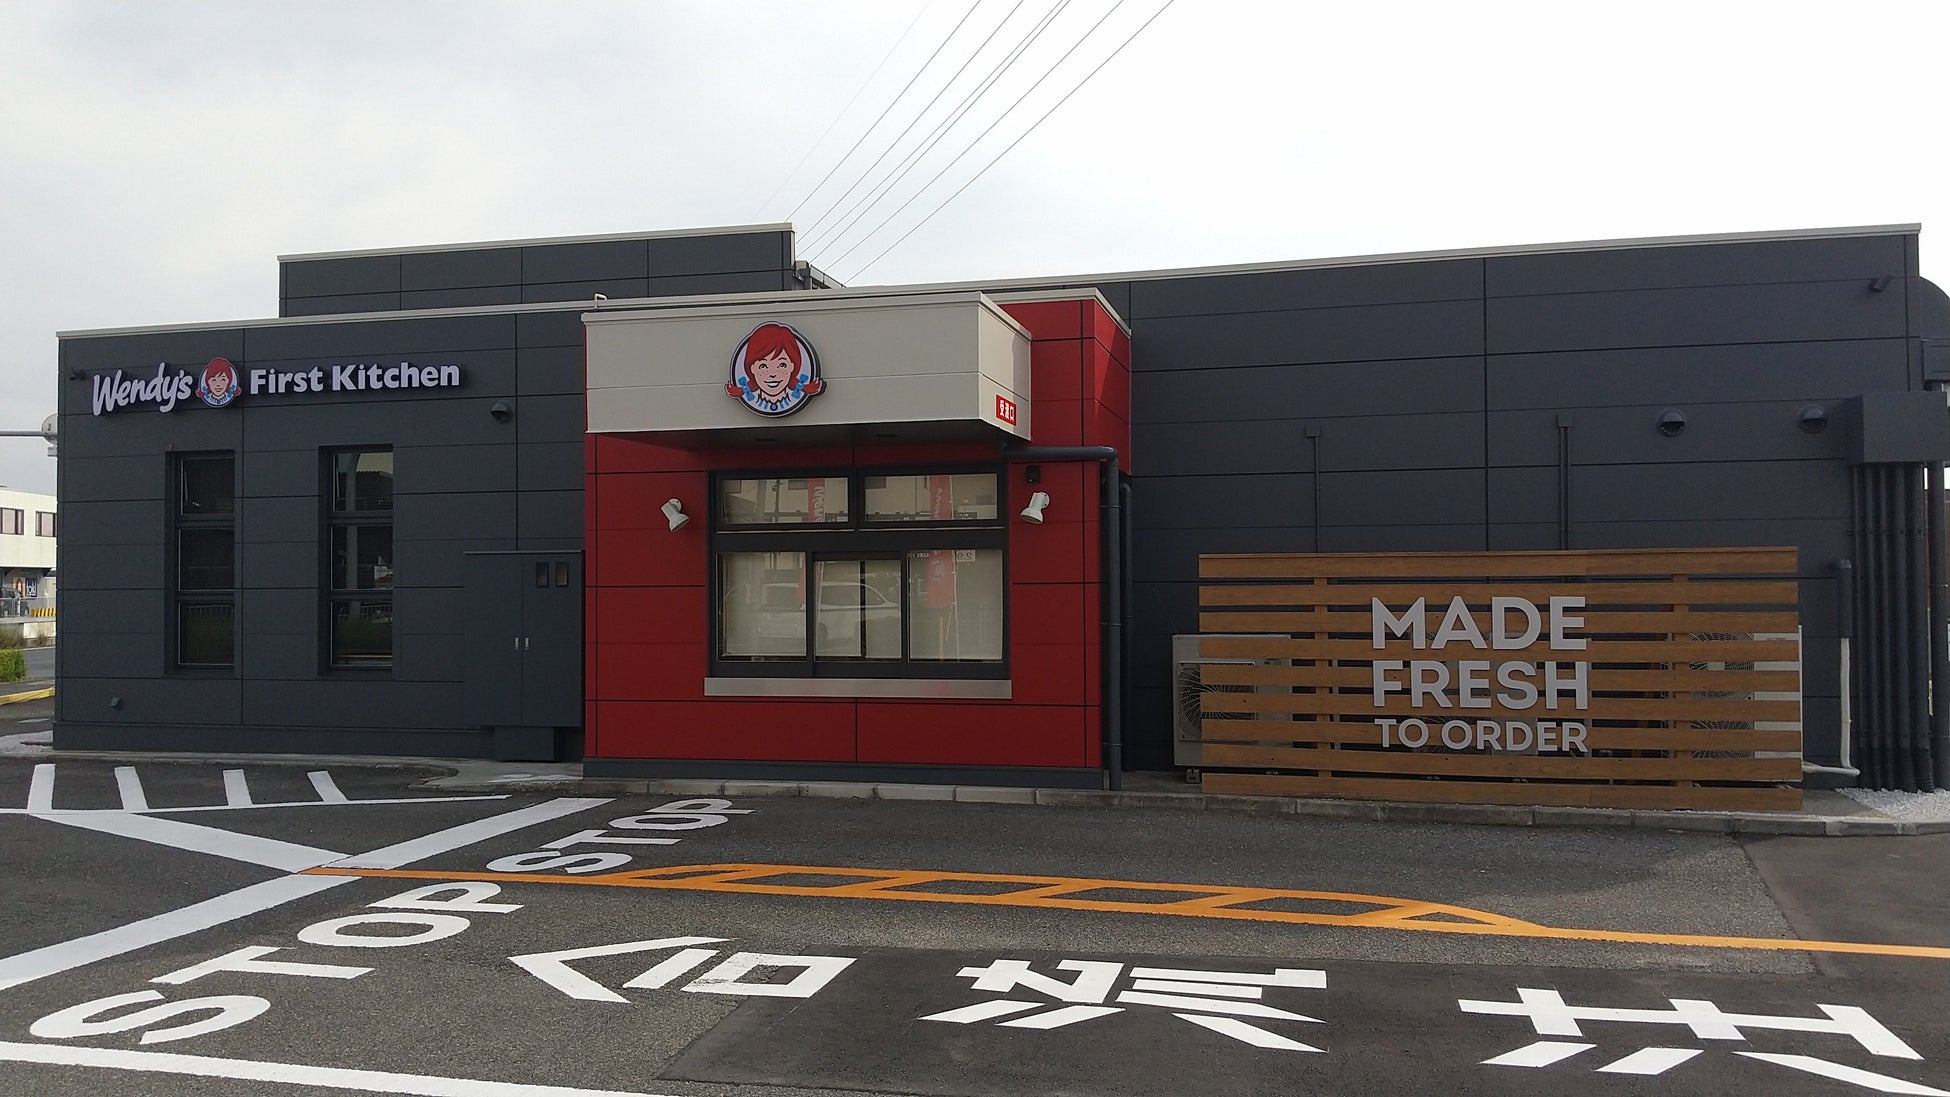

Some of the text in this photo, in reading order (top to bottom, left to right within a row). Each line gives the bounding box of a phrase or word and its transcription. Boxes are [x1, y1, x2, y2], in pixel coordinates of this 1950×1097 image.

[92, 361, 460, 416] Wendy's First Kitchen
[1371, 595, 1588, 650] MADE
[1372, 660, 1589, 710] FRESH
[1374, 718, 1589, 752] TO ORDER
[486, 798, 755, 874] STOP
[29, 881, 525, 1045] STOP
